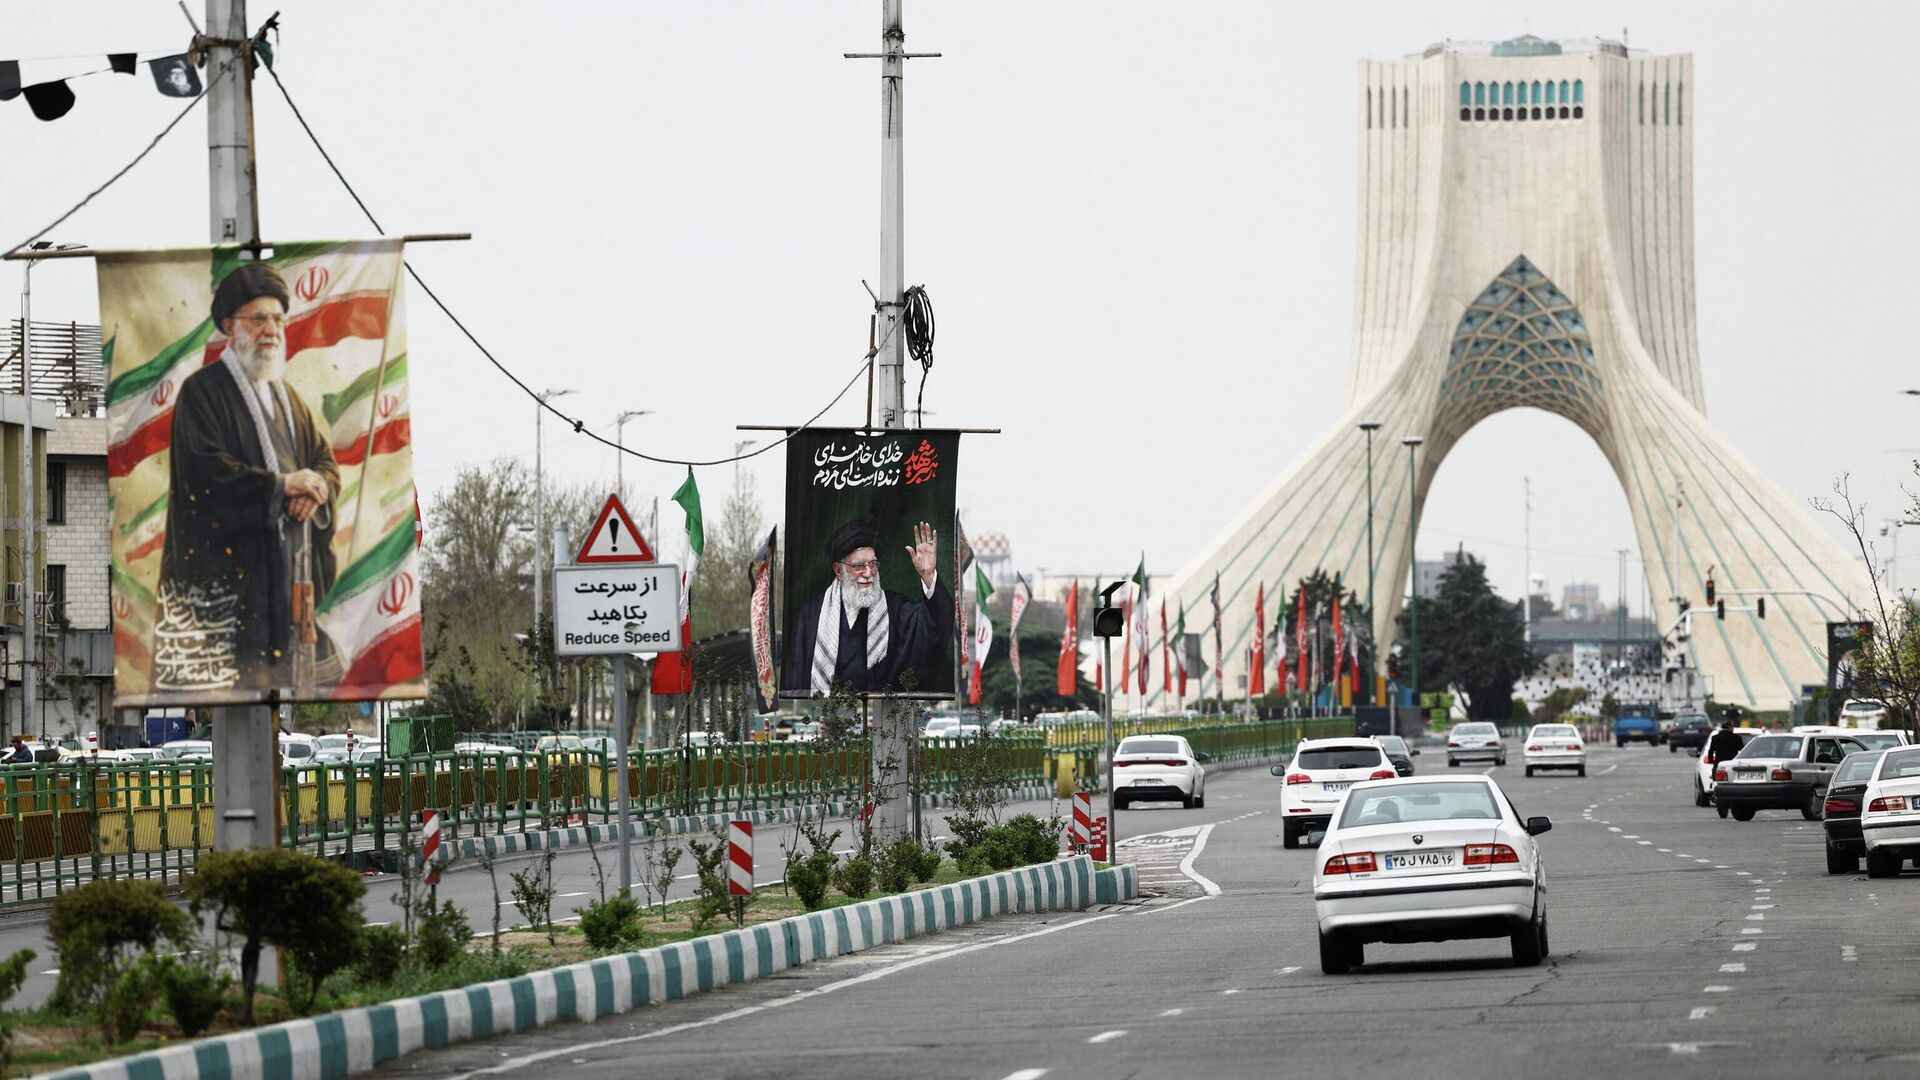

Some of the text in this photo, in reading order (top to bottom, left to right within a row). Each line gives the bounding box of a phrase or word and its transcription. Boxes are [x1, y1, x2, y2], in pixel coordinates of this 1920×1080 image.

[872, 440, 904, 468] خدای
[812, 460, 901, 490] زنده است ای مردم
[574, 576, 657, 598] از سرعت
[587, 605, 648, 625] بکاهید
[565, 630, 671, 645] Reduce Speed
